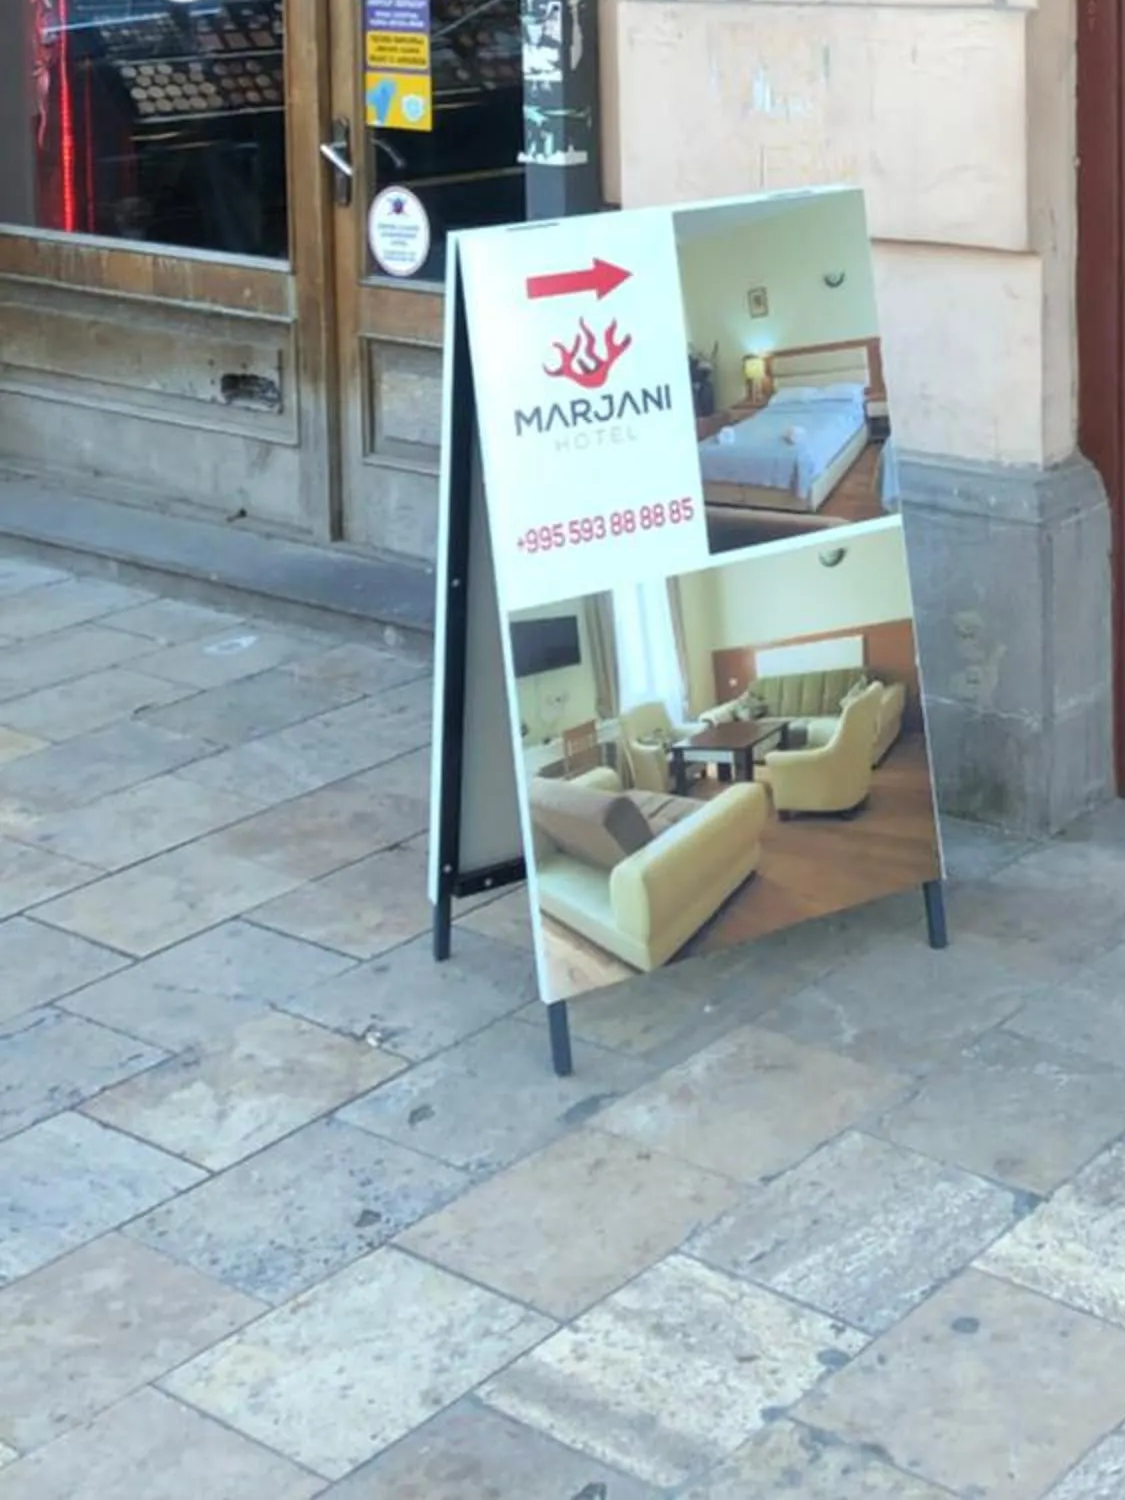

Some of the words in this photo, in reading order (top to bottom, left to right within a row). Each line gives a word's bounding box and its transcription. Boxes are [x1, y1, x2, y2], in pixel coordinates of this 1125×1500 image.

[514, 384, 672, 436] MARJANI
[555, 426, 638, 452] HOTEL
[517, 523, 566, 554] +995
[568, 516, 607, 545] 593
[610, 510, 637, 536] 88
[640, 503, 667, 530] 88
[668, 497, 694, 524] 85
